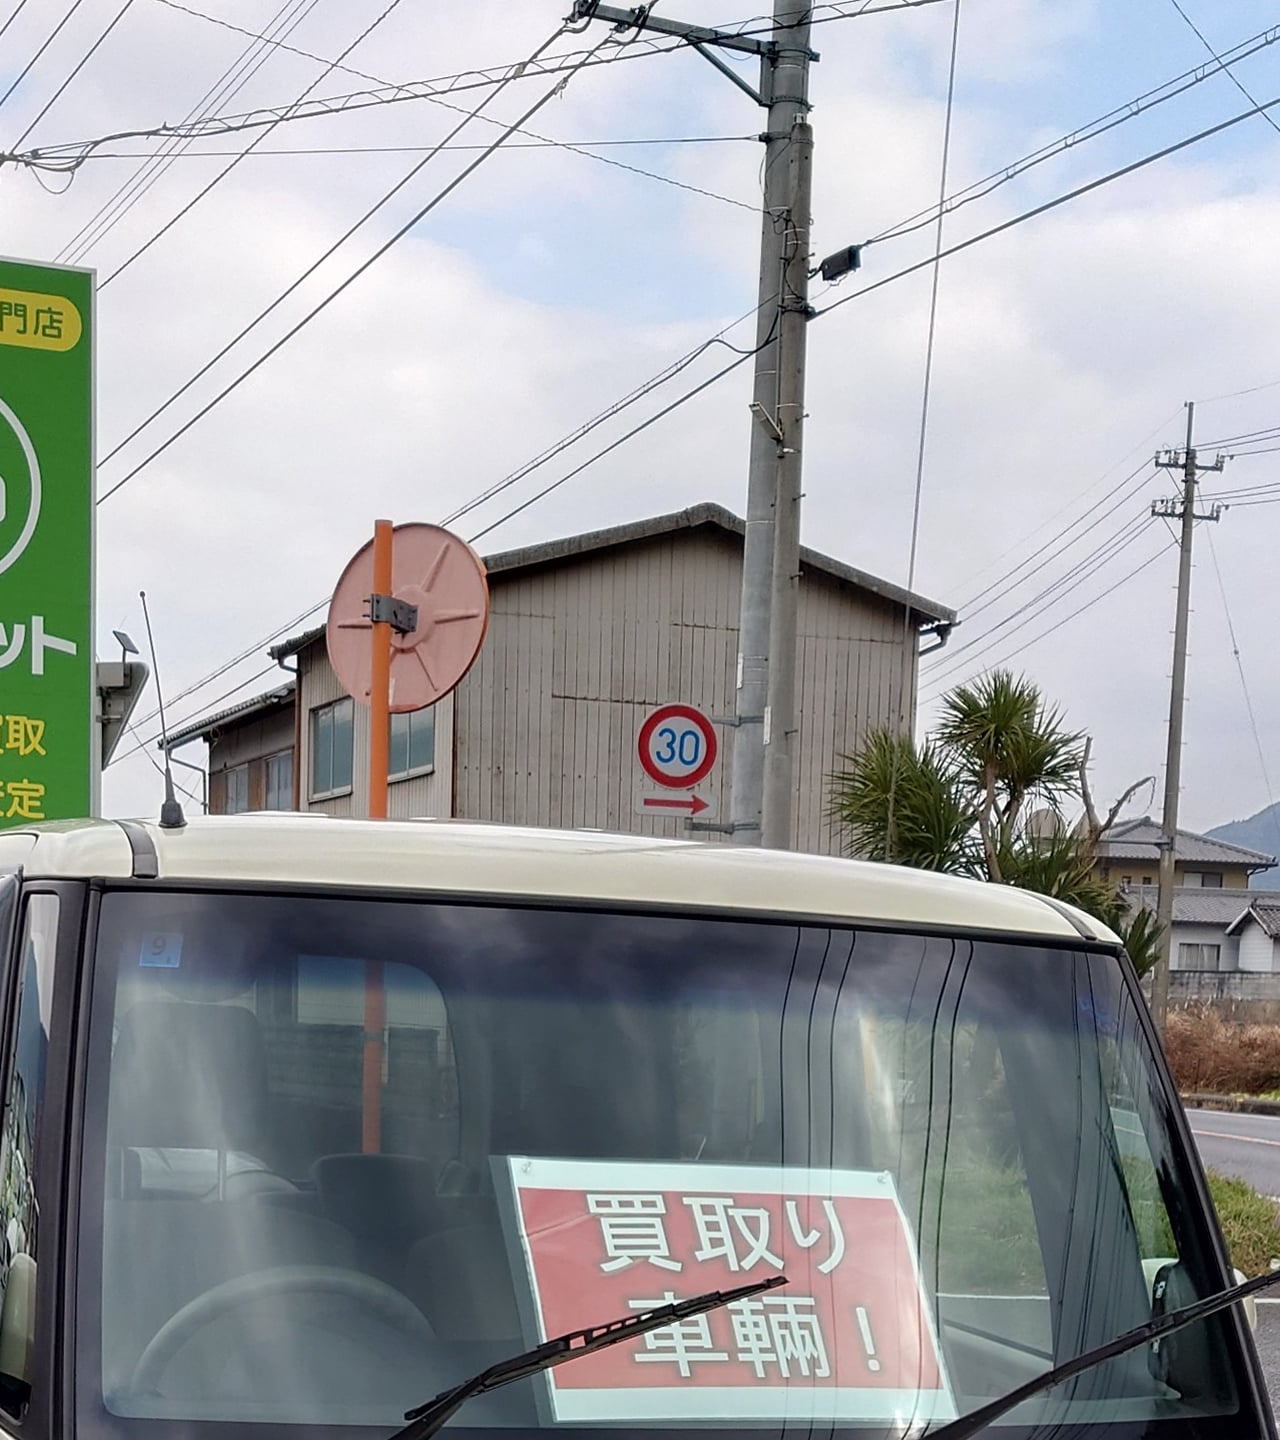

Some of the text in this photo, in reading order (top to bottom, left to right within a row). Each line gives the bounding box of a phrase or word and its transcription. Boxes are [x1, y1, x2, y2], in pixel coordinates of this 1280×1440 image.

[656, 728, 700, 766] 30
[586, 1193, 845, 1274] 買取り
